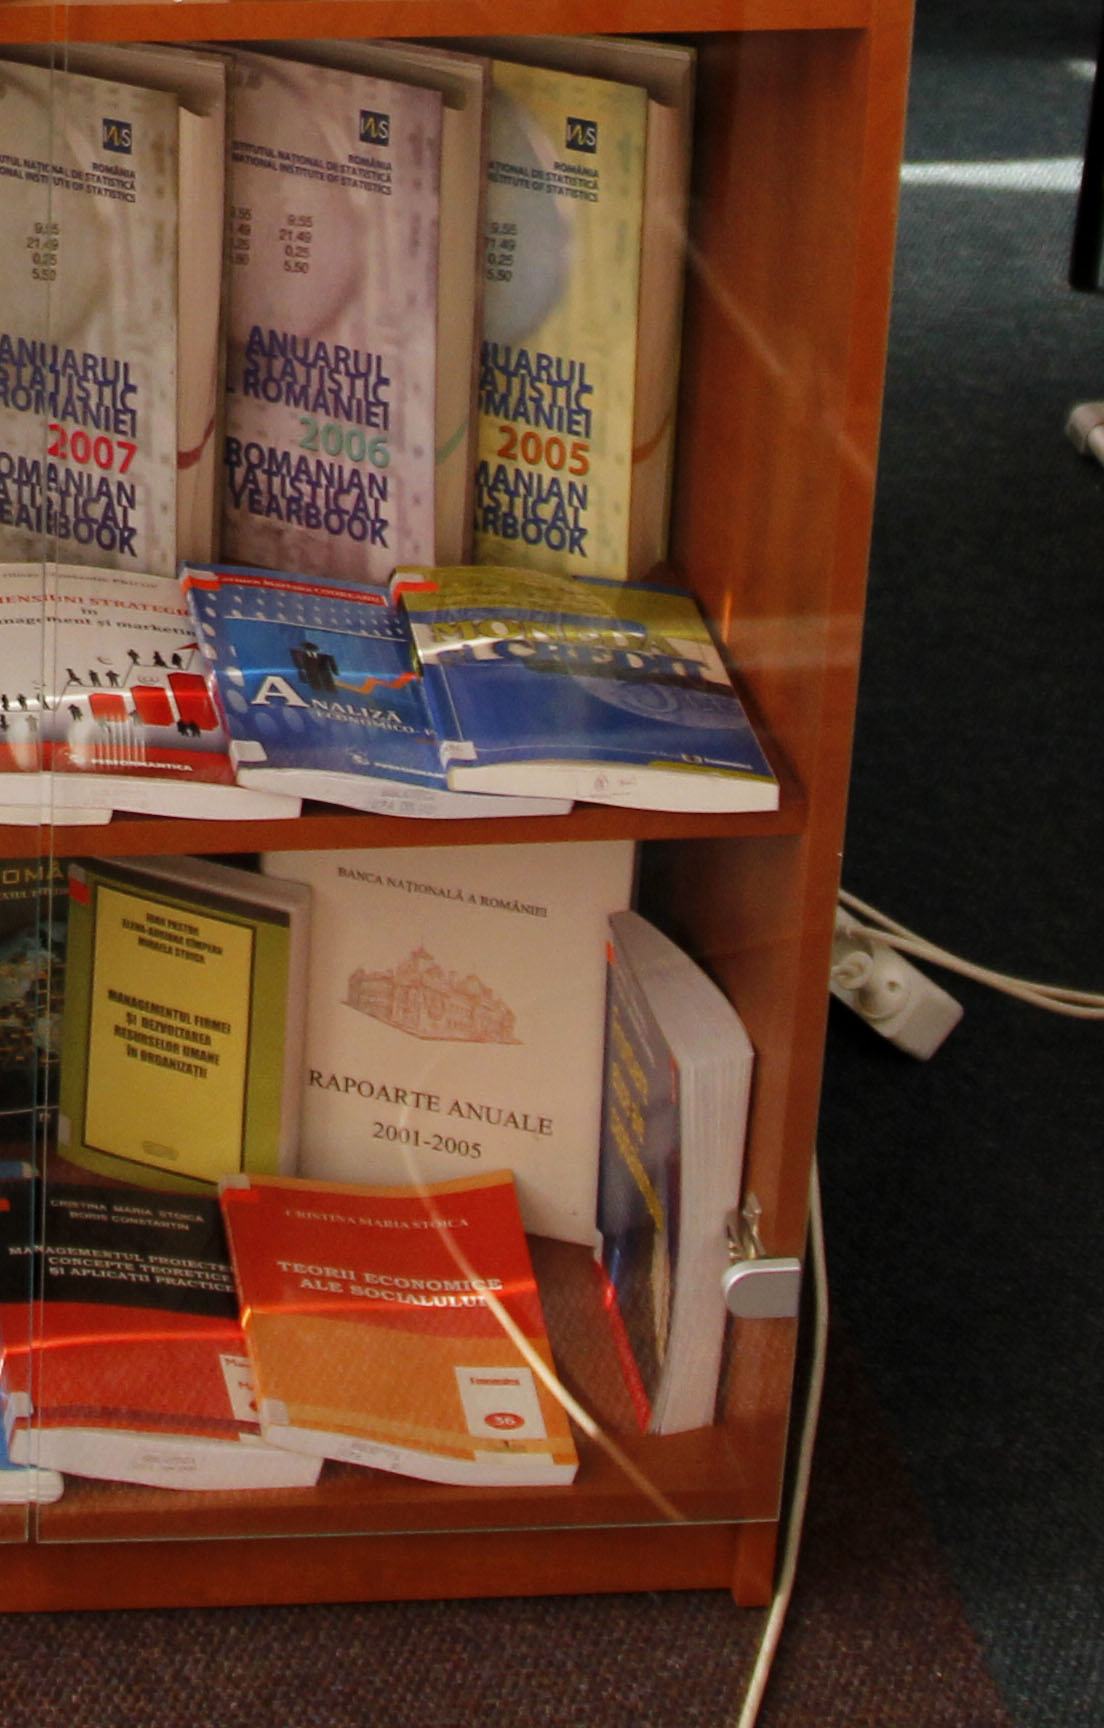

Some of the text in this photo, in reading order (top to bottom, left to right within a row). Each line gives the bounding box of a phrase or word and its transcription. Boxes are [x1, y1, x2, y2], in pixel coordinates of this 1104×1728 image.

[249, 326, 390, 383] ANUARUL
[48, 424, 138, 474] 2007
[299, 417, 390, 468] 2006
[497, 425, 590, 475] 2005
[225, 435, 388, 502] ROMANIAN
[230, 487, 389, 549] YEARBOOK
[92, 758, 193, 772] PERFORMANTICA
[338, 867, 383, 885] BANCA
[467, 894, 477, 905] A
[480, 895, 547, 917] ROMÂNIEI
[108, 989, 231, 1035] MANAGEMENTUL FIRMEI
[182, 1045, 220, 1066] UMANE
[309, 1069, 554, 1136] RAPOARTE ANUALE
[372, 1122, 482, 1160] 2001-2005
[50, 1198, 205, 1223] CRISTINA MARIA STOICA
[111, 1215, 190, 1232] CONSTANTIN
[284, 1209, 469, 1229] CRISTINA MARIA STOICA
[8, 1246, 144, 1263] MANAGEMENTUL
[48, 1256, 231, 1284] CONCEPTE TEORETICE
[276, 1260, 503, 1293] TEORII ECONOMICE
[299, 1278, 490, 1310] ALE SOCIALULUI
[493, 1414, 516, 1427] 36
